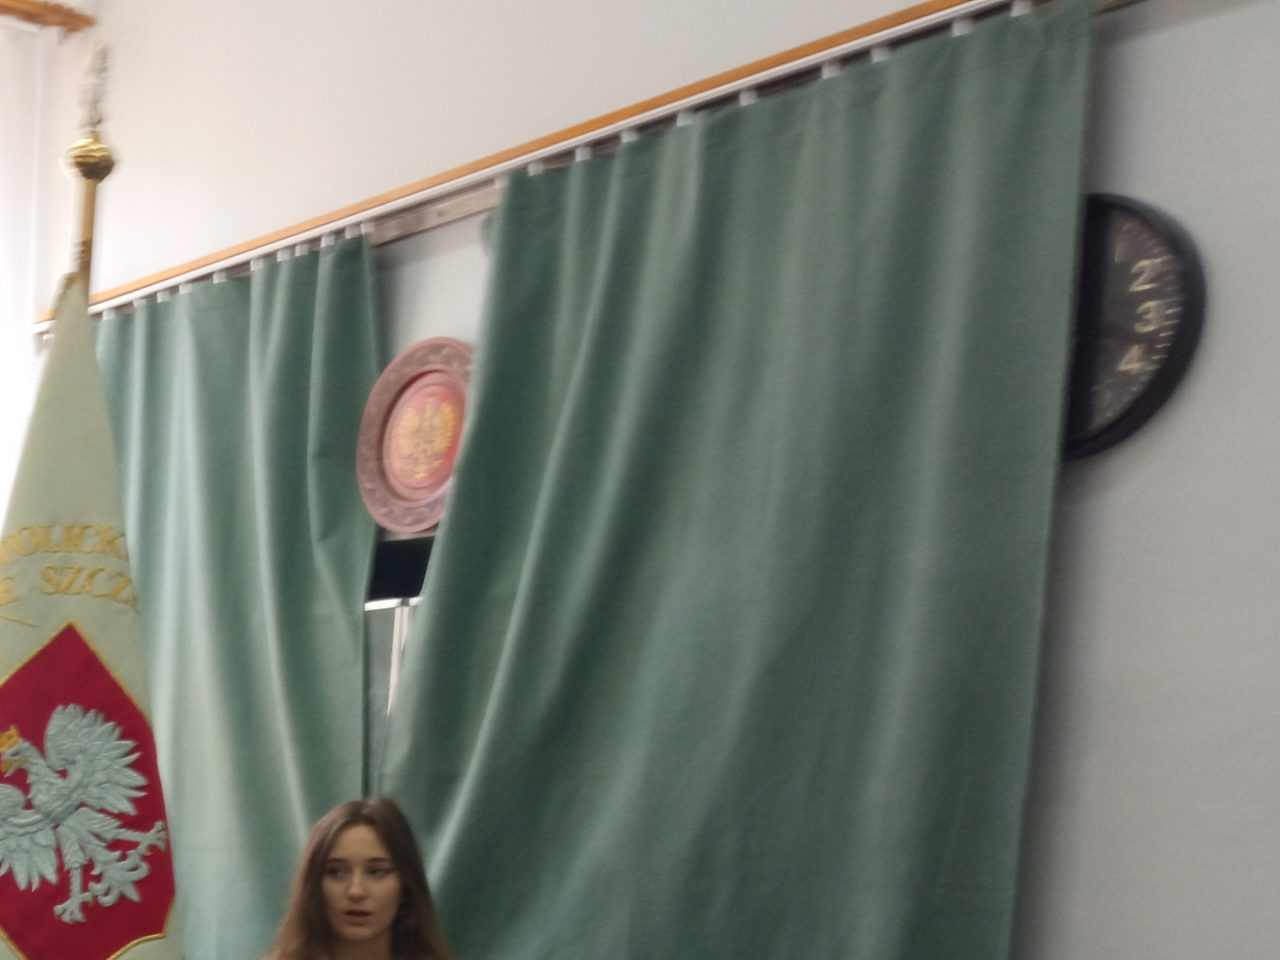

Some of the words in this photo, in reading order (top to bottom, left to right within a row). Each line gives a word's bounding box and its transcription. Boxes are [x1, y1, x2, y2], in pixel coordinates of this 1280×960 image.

[1129, 257, 1161, 292] 2
[1134, 301, 1162, 333] 3
[1117, 344, 1148, 372] 4
